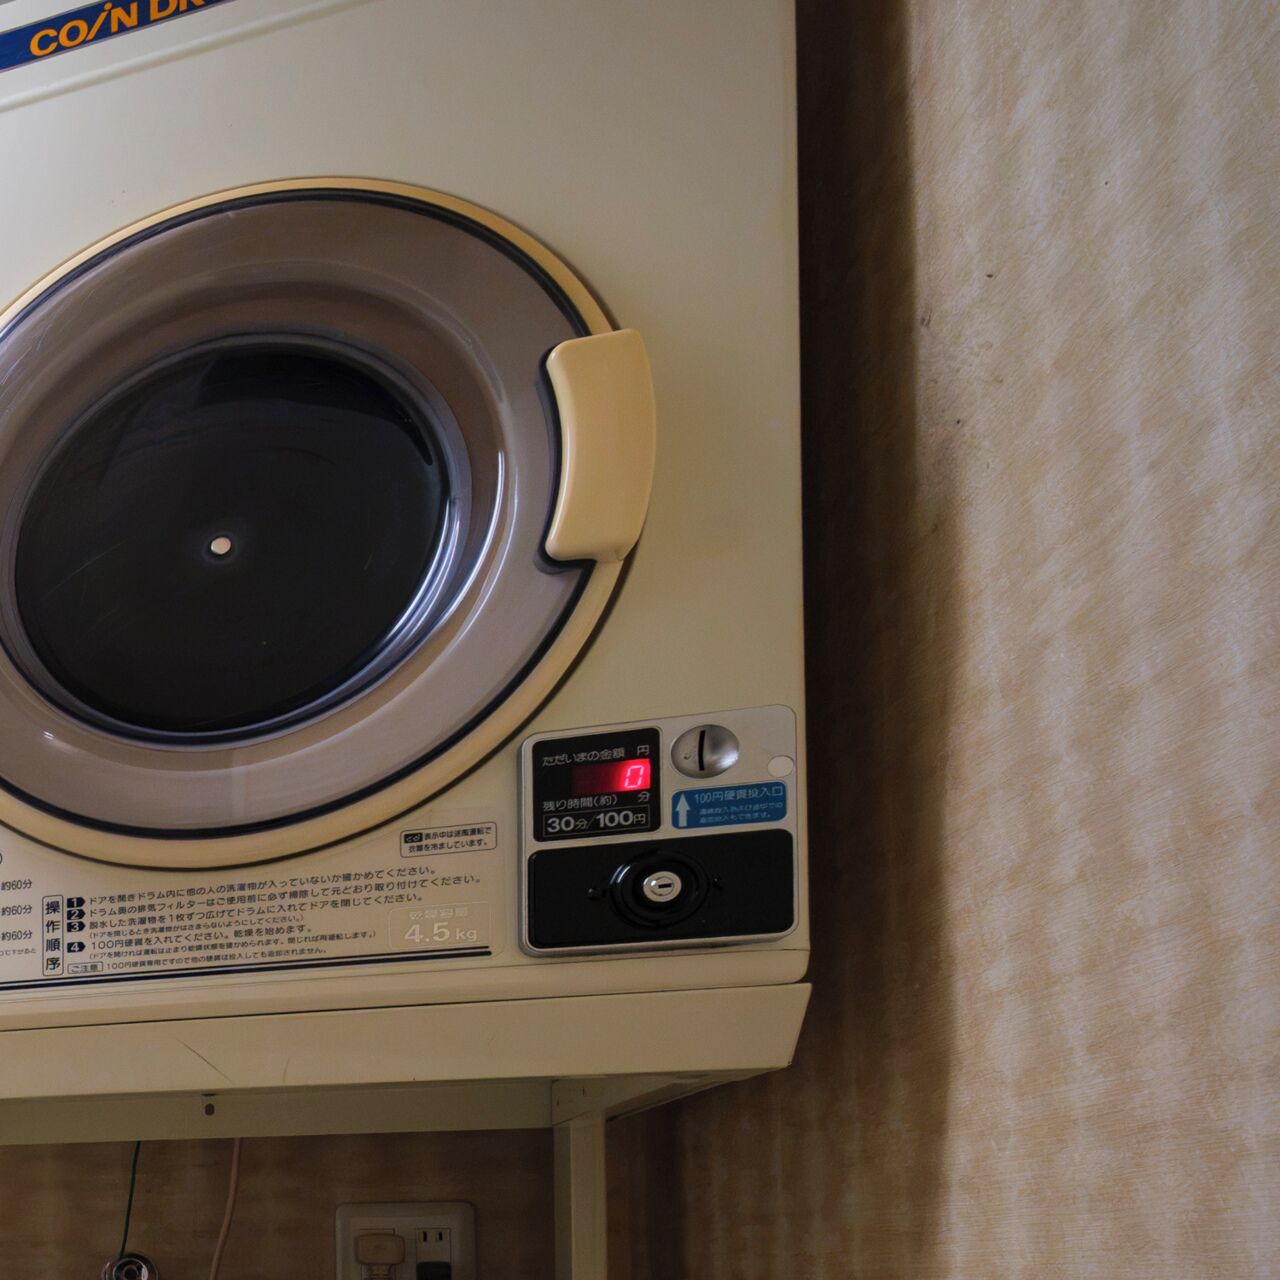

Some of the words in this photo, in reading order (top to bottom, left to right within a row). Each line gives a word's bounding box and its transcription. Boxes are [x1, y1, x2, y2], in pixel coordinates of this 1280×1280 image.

[636, 744, 650, 756] 円
[1, 879, 33, 891] 約60分
[1, 904, 33, 917] 約60分
[1, 929, 33, 941] 約60分
[45, 900, 61, 971] 操作順序
[404, 921, 450, 943] 4.5
[455, 927, 478, 943] kg
